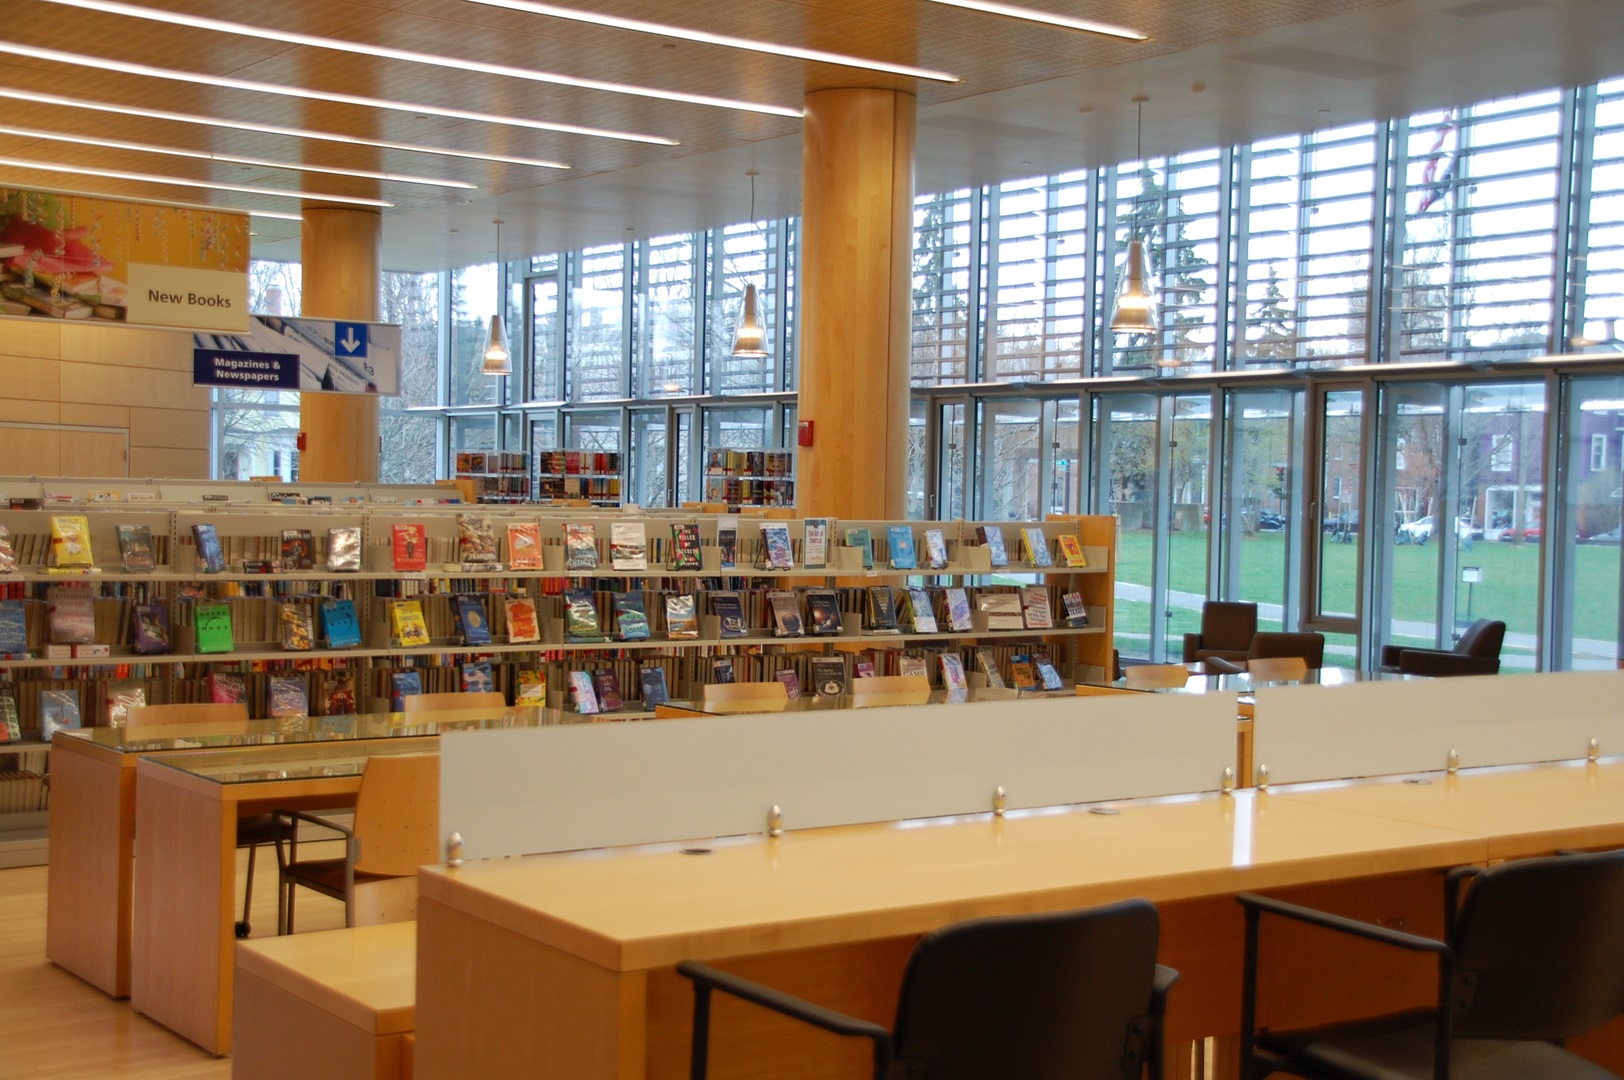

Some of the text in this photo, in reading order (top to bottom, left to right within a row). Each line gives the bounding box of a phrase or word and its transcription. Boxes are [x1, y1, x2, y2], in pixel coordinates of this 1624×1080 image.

[148, 289, 232, 309] New Books
[214, 357, 281, 371] Magazines &
[216, 368, 280, 383] Newspapers
